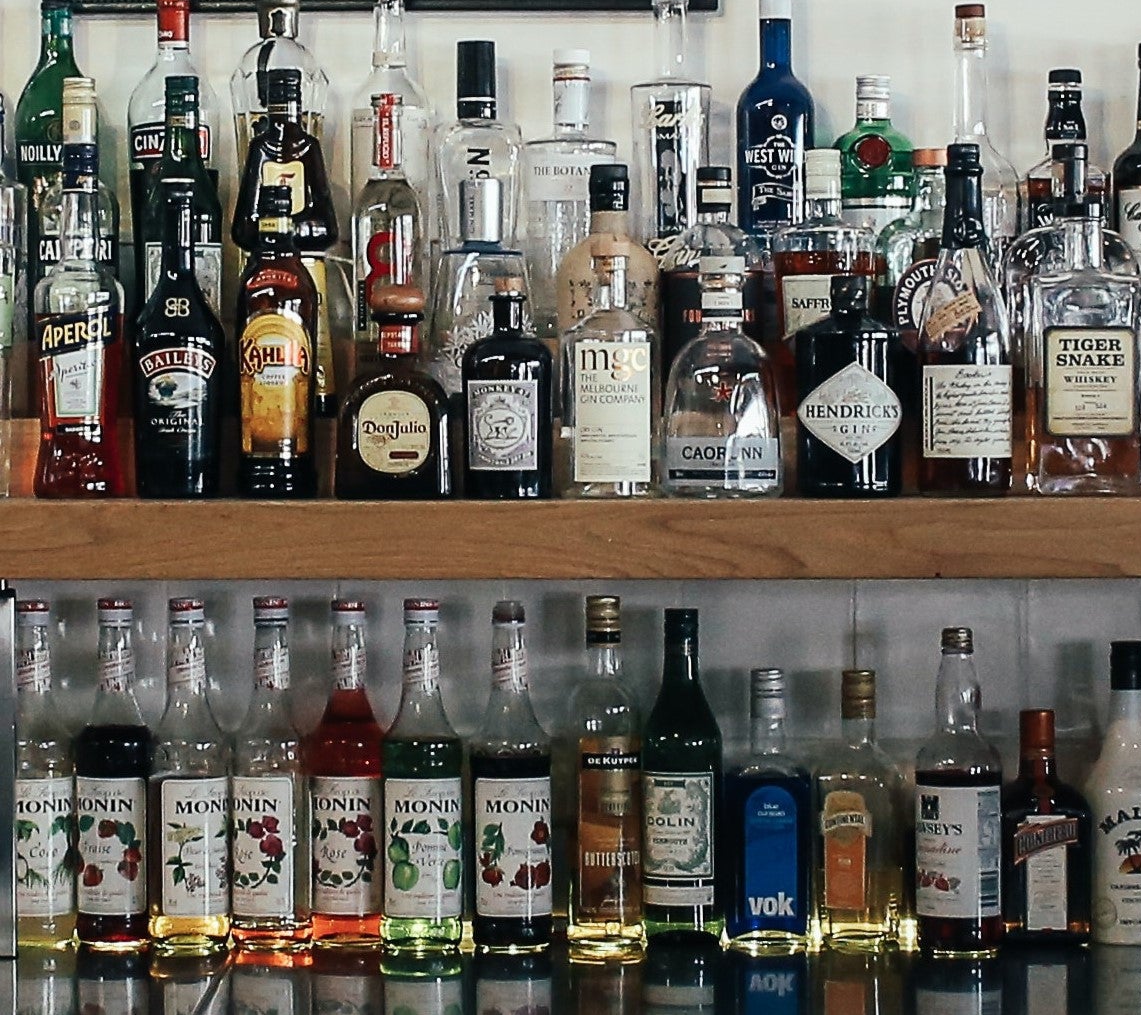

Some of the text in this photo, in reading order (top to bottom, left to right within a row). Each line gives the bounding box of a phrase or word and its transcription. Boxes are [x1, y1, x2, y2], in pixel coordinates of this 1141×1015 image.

[20, 144, 62, 163] NOILLY
[42, 317, 112, 351] APEROL
[1058, 338, 1122, 352] TIGER
[580, 346, 648, 381] mgc
[1055, 353, 1126, 367] SNAKE
[579, 373, 597, 383] THE
[1063, 375, 1118, 384] WHISKEY
[805, 404, 899, 419] HENDRICK'S
[838, 424, 870, 434] GIN
[681, 445, 763, 461] CAORNN
[394, 799, 460, 814] MONIN
[485, 799, 550, 815] MONIN
[748, 891, 796, 917] vok
